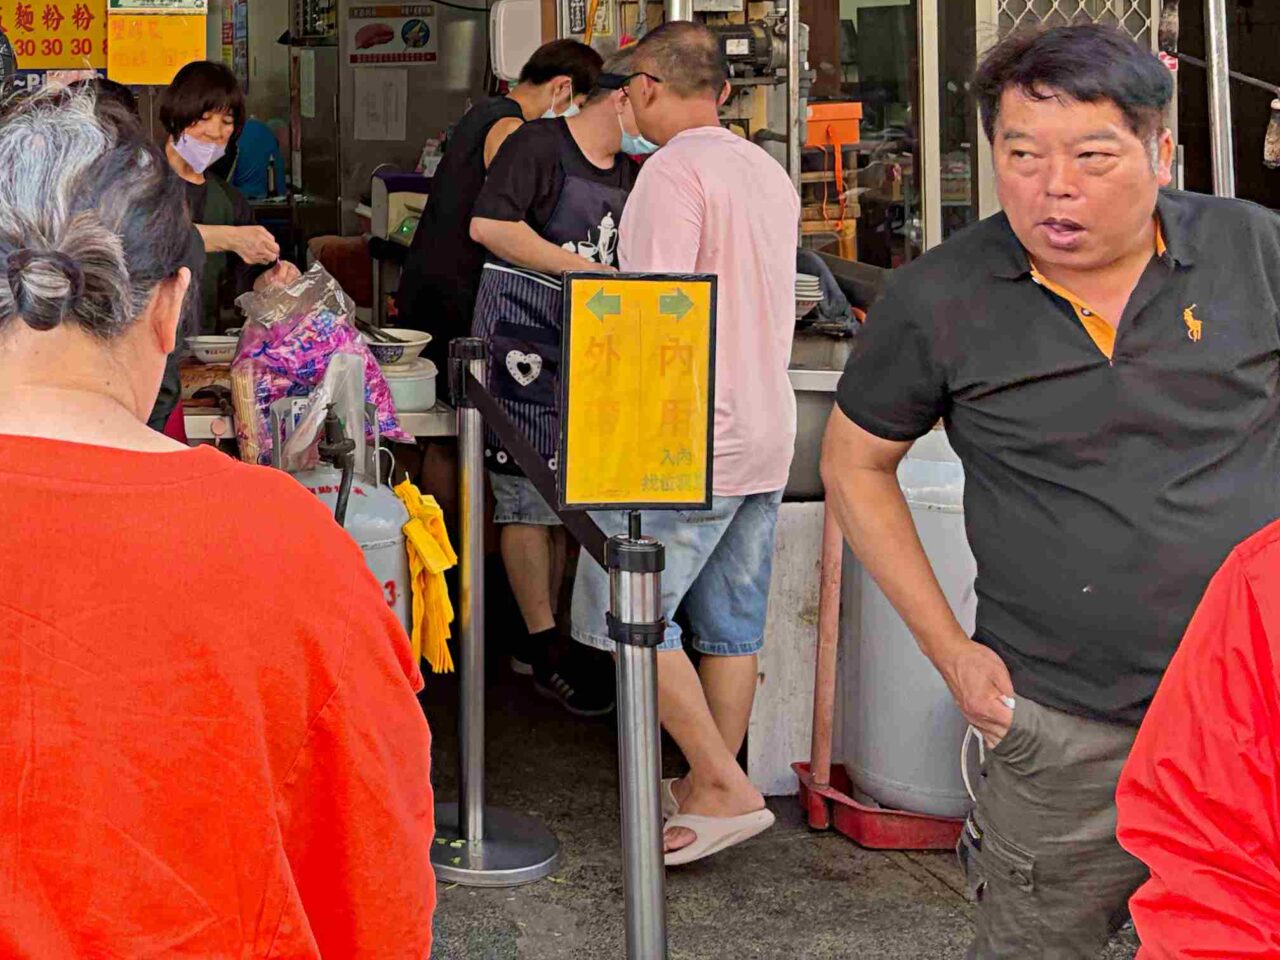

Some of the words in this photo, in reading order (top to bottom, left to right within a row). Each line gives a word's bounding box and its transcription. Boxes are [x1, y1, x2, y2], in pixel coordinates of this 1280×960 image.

[15, 39, 36, 56] 30
[41, 39, 63, 56] 30
[71, 38, 93, 56] 30
